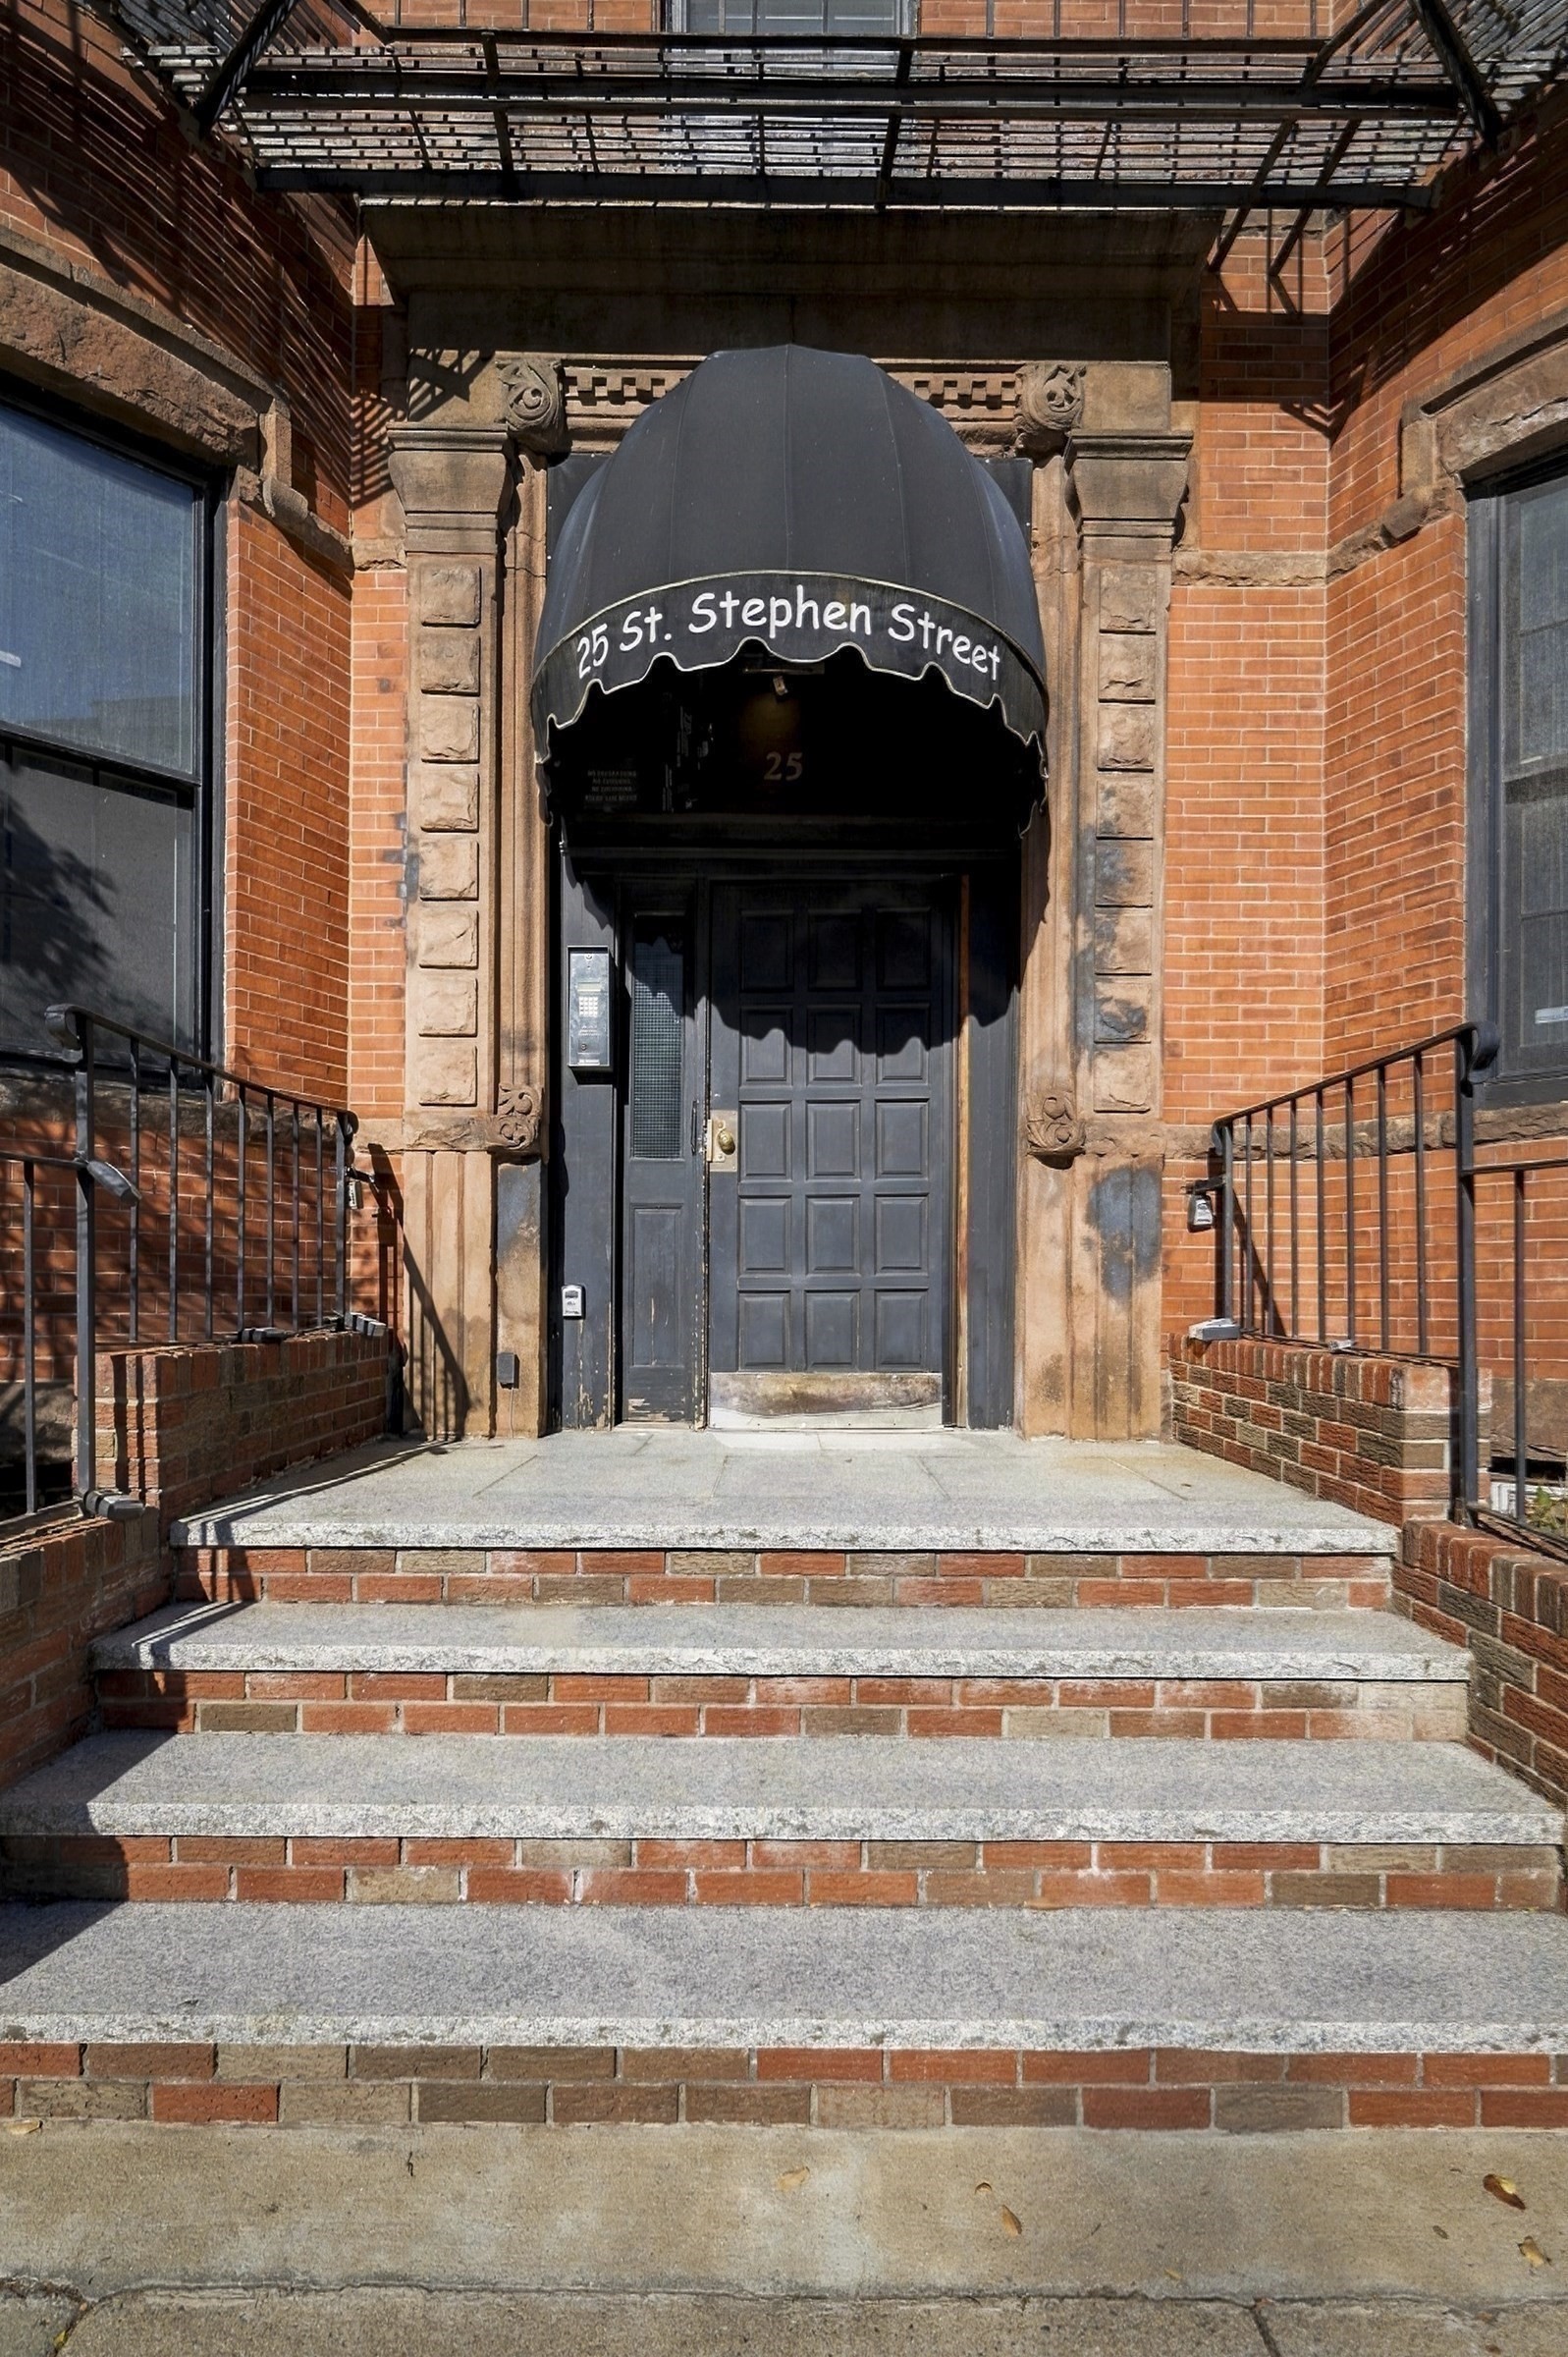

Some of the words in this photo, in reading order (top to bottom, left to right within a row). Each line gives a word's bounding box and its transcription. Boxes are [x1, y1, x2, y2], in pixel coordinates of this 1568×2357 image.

[576, 623, 609, 680] 25
[619, 606, 674, 652] St.
[688, 583, 872, 639] Stephen
[888, 603, 1000, 681] Street
[764, 751, 803, 781] 25
